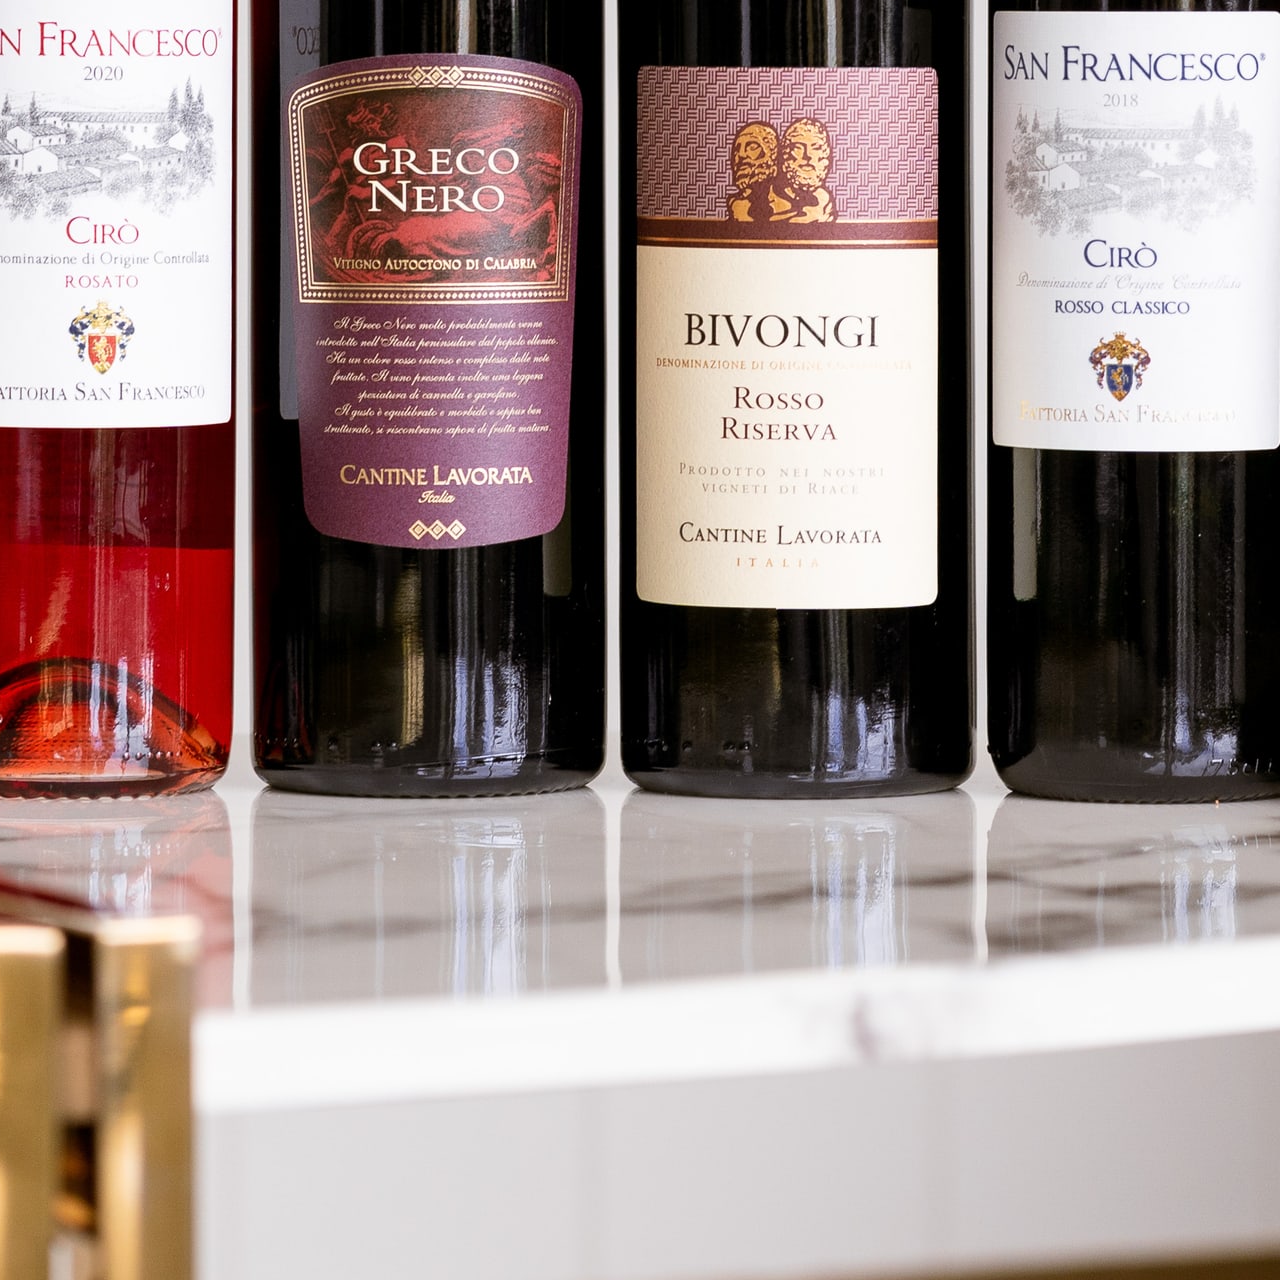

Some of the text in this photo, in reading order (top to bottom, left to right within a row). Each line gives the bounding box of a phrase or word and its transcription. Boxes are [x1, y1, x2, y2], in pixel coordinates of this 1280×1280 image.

[38, 21, 218, 57] FRANCESCO
[1005, 44, 1049, 81] SAN
[83, 66, 123, 81] 2020
[1103, 93, 1138, 108] 2018
[353, 142, 520, 175] GRECO
[368, 180, 505, 212] NERO
[66, 216, 139, 244] CIRÒ
[82, 251, 95, 265] di
[100, 251, 150, 269] Origine
[154, 251, 209, 265] Controllata
[1083, 238, 1158, 269] CIRÒ
[333, 256, 537, 271] VITIGNO AUTOCTONO DI CALABRIA
[65, 275, 139, 288] ROSATO
[1016, 271, 1094, 289] Denominazione
[1095, 273, 1108, 289] di
[1115, 274, 1165, 296] Origine
[1054, 299, 1190, 315] ROSSO CLASSICO
[334, 316, 350, 330] Il
[351, 316, 381, 332] Greco
[383, 316, 416, 330] Nero
[419, 318, 446, 330] molto
[447, 317, 517, 333] probabilmente
[683, 312, 879, 348] BIVONGI
[316, 335, 358, 347] introdotto
[416, 337, 476, 350] peninsulare
[478, 335, 494, 347] dal
[495, 335, 526, 350] popolo
[326, 351, 346, 364] Ha
[363, 353, 391, 365] colore
[419, 355, 454, 365] intenso
[509, 353, 531, 363] dalle
[533, 354, 550, 362] note
[656, 357, 746, 370] DENOMINAZIONE
[751, 360, 764, 370] DI
[330, 370, 369, 385] fruttate.
[371, 369, 389, 382] Il
[390, 373, 412, 382] vino
[412, 373, 455, 385] presenta
[457, 370, 490, 382] inoltre
[512, 371, 544, 385] leggera
[75, 382, 112, 401] SAN
[119, 382, 205, 401] FRANCESCO
[409, 389, 420, 400] di
[421, 389, 465, 400] cannella
[474, 389, 520, 404] garofano.
[733, 385, 824, 410] ROSSO
[334, 404, 350, 417] Il
[350, 408, 375, 421] gusto
[384, 406, 438, 420] equilibrato
[447, 406, 488, 417] morbido
[526, 405, 542, 415] ben
[1018, 400, 1088, 423] FATTORIA
[1094, 404, 1129, 423] SAN
[386, 425, 442, 435] riscontrano
[444, 425, 476, 438] sapori
[477, 424, 487, 433] di
[487, 423, 516, 437] frutta
[720, 416, 837, 441] RISERVA
[340, 464, 534, 486] CANTINE LAVORATA
[679, 462, 884, 478] PRODOTTO NEI NOSTRI
[418, 490, 456, 504] Italia
[702, 482, 860, 495] VIGNETI DI RIACE
[678, 521, 882, 545] CANTINE LAVORATA
